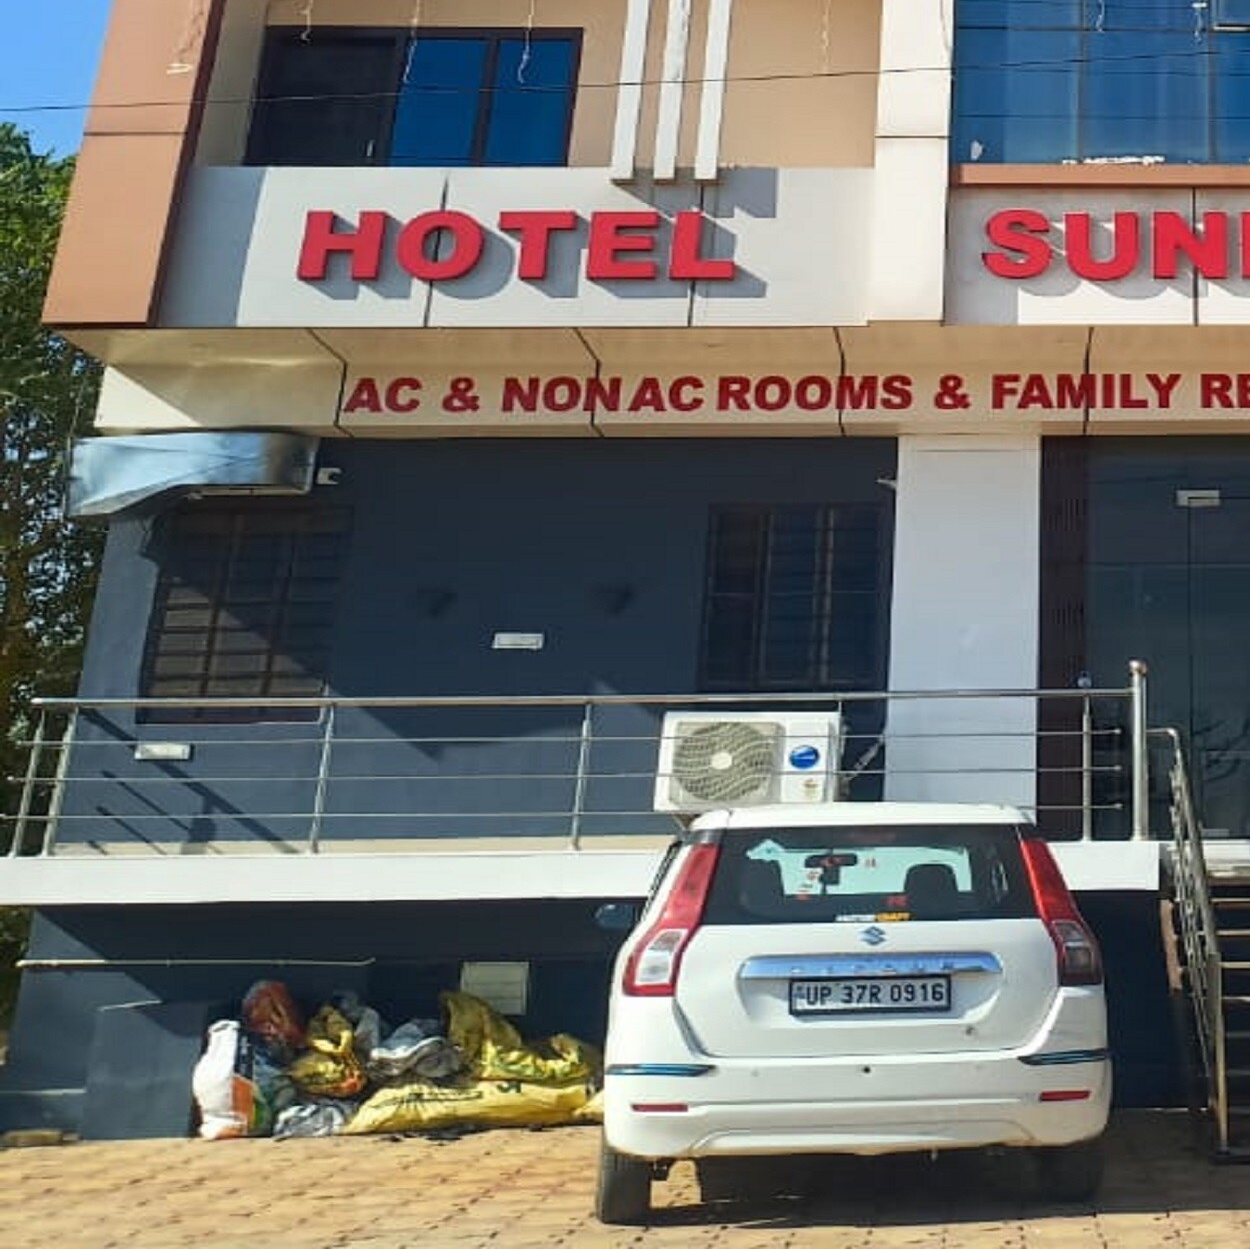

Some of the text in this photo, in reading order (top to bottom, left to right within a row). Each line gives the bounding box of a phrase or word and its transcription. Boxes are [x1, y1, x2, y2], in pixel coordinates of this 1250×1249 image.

[298, 210, 736, 282] HOTEL
[345, 377, 422, 413] AC
[442, 376, 480, 412] &
[716, 375, 914, 412] ROOMS
[933, 374, 971, 410] &
[992, 373, 1181, 410] FAMILY
[806, 983, 944, 1005] UP 37R 0916
